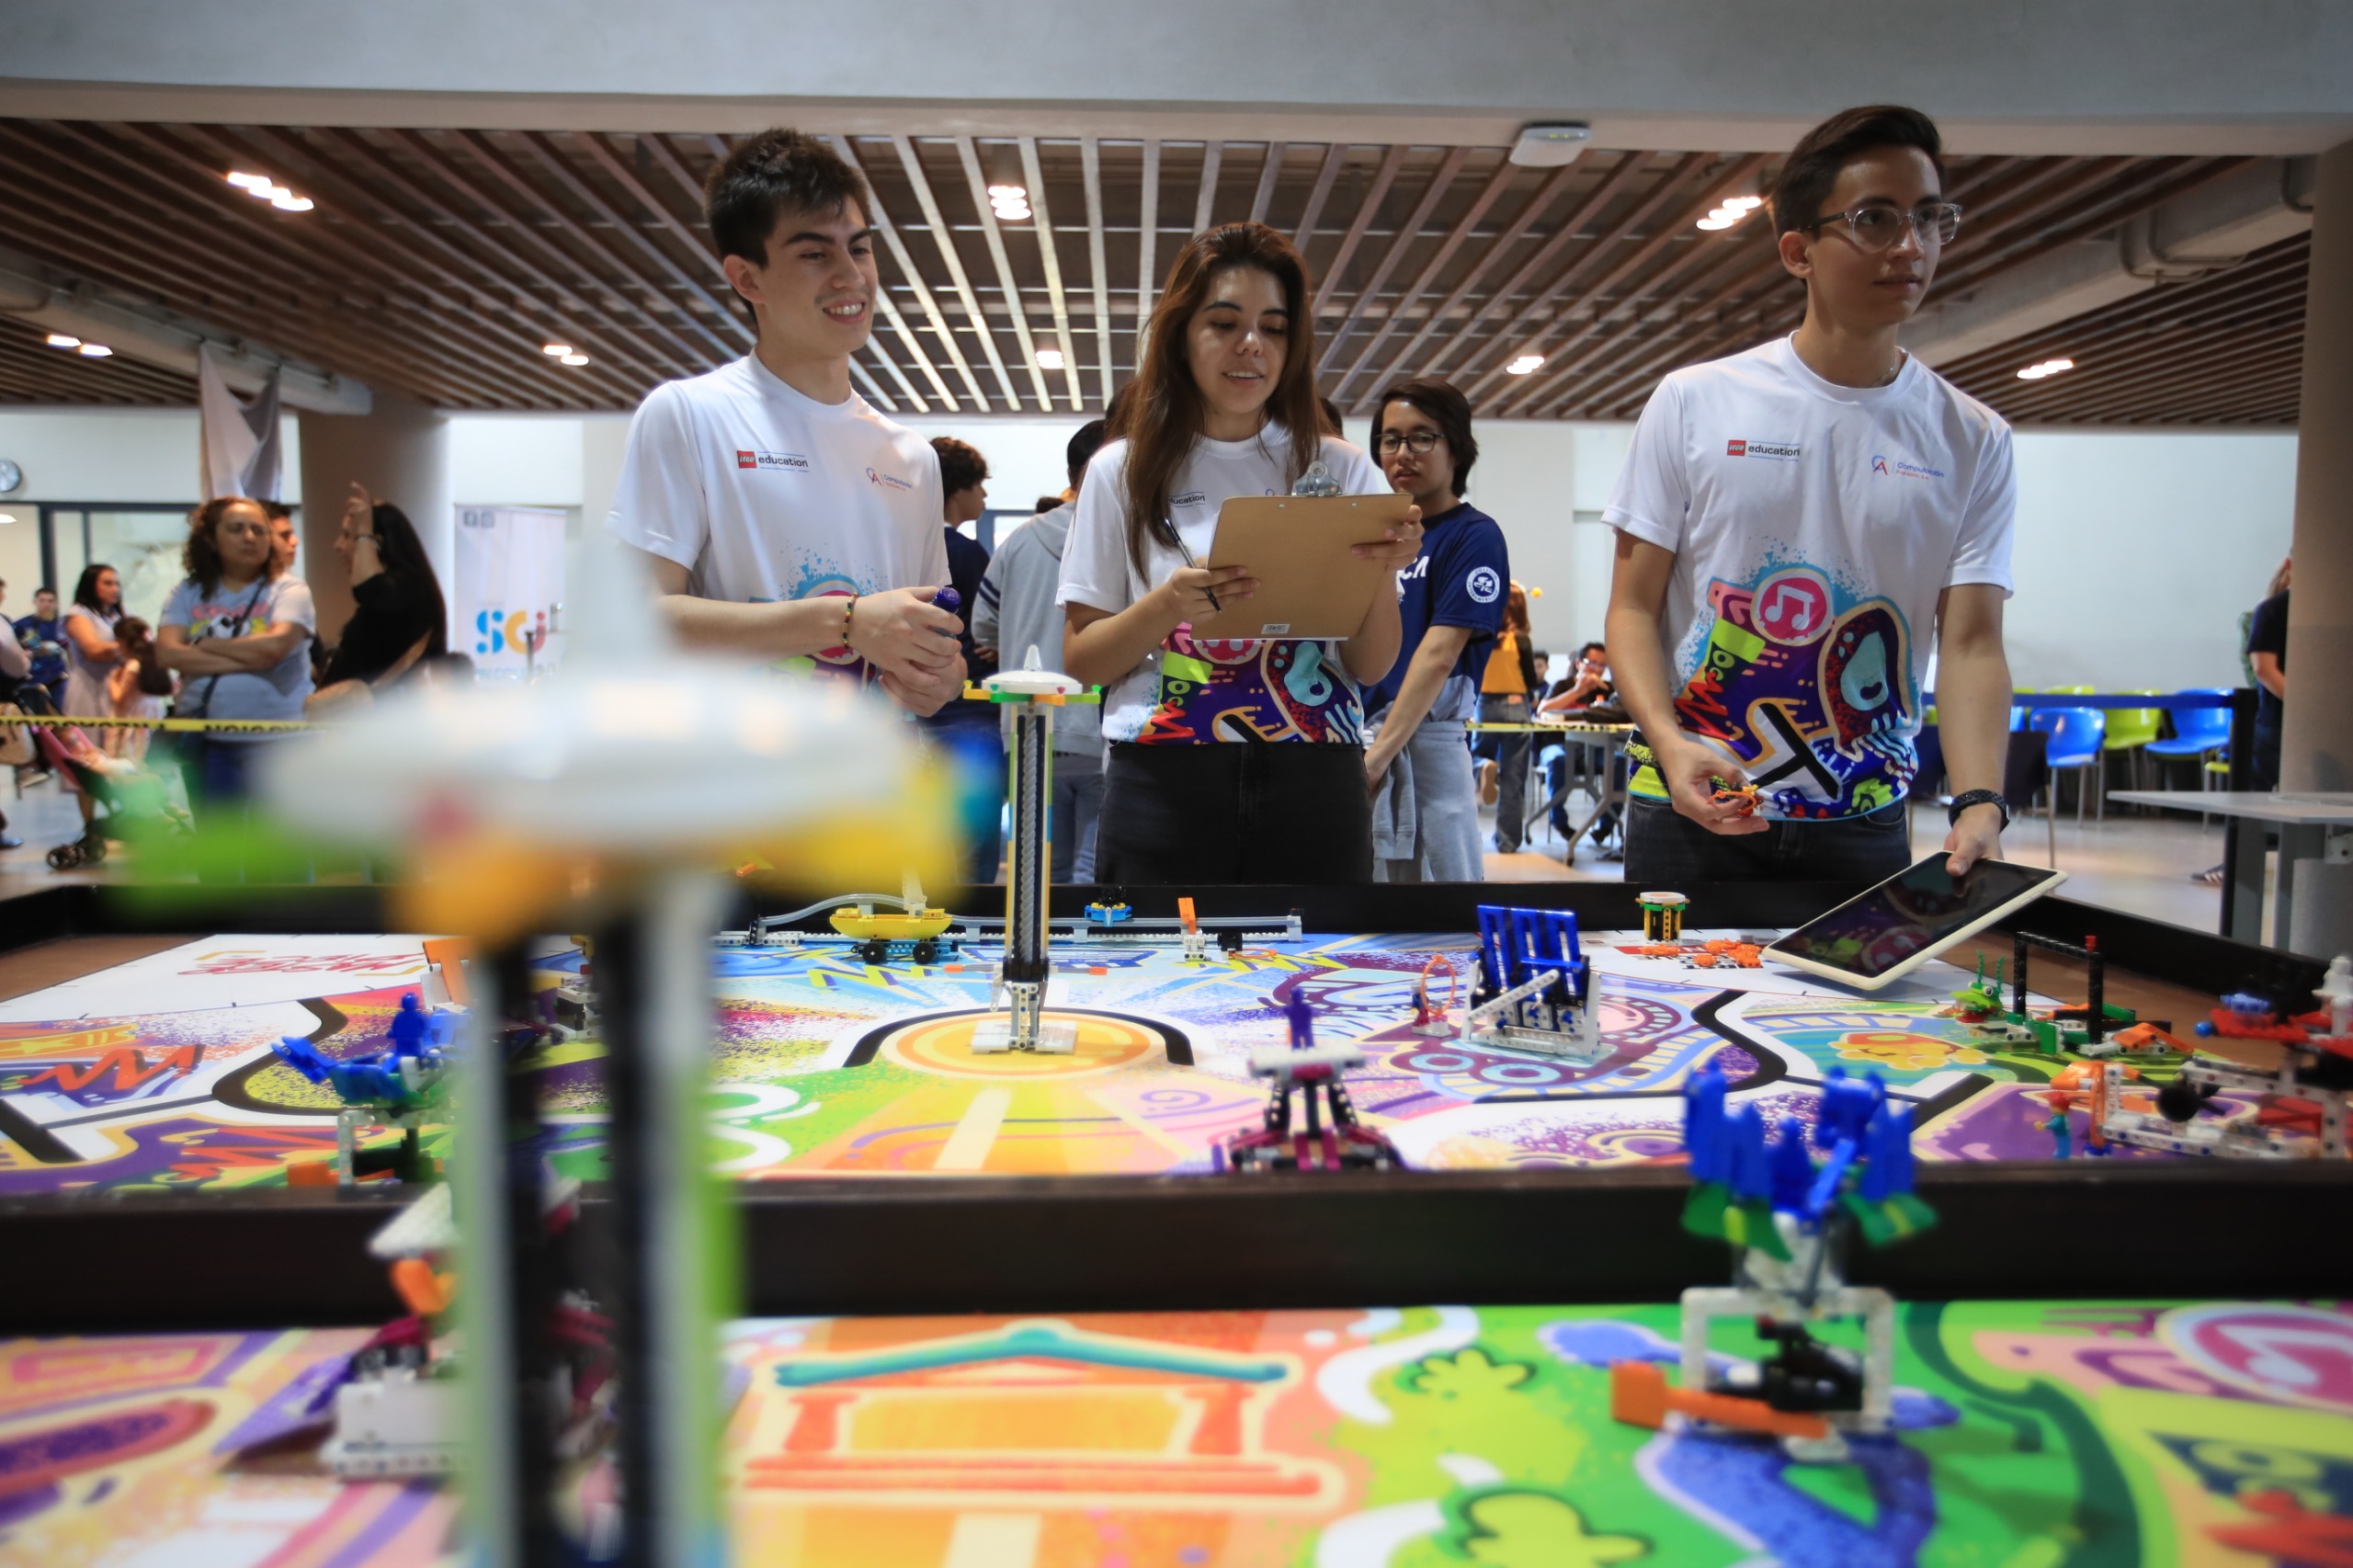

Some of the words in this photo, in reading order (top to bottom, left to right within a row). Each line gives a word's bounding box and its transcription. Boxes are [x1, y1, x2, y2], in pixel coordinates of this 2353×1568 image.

[1748, 444, 1801, 457] education
[758, 454, 809, 468] education
[1169, 494, 1206, 505] ducation
